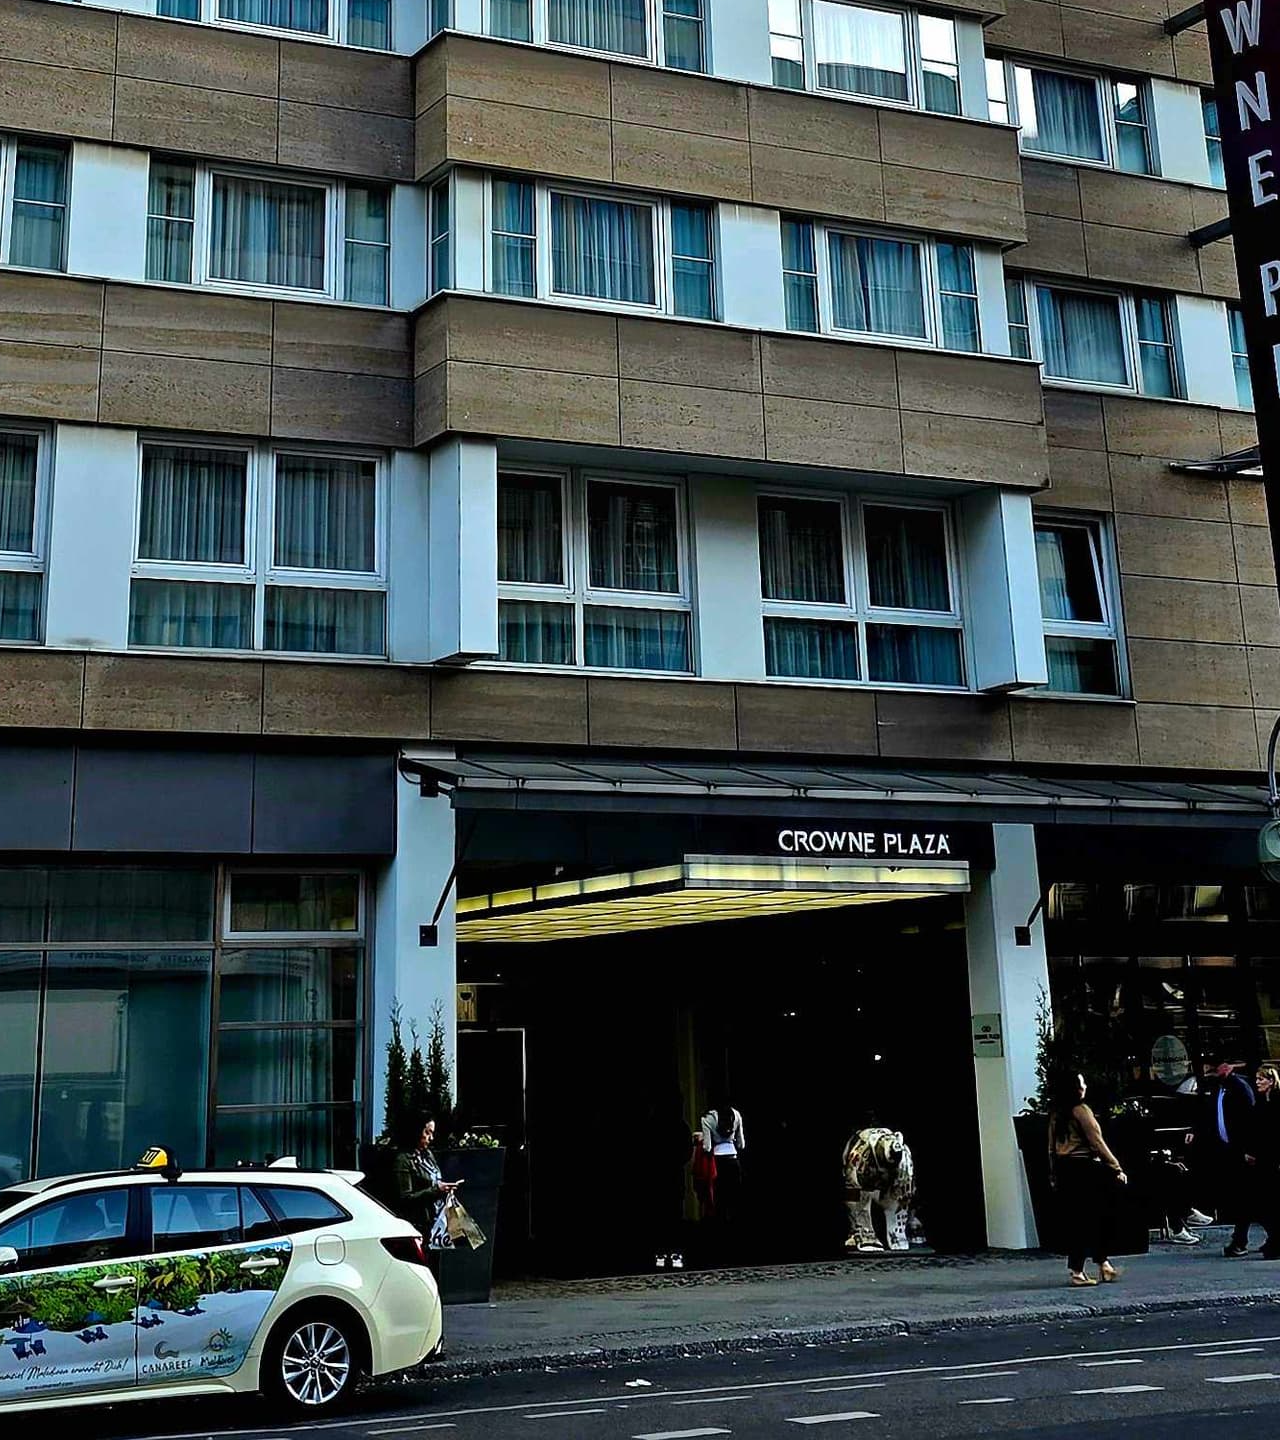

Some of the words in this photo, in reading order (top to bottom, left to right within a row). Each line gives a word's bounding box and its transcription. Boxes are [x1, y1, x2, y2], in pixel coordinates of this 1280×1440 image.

[778, 829, 876, 853] CROWNE
[883, 832, 951, 854] PLAZA
[142, 1358, 192, 1374] CANAREEF
